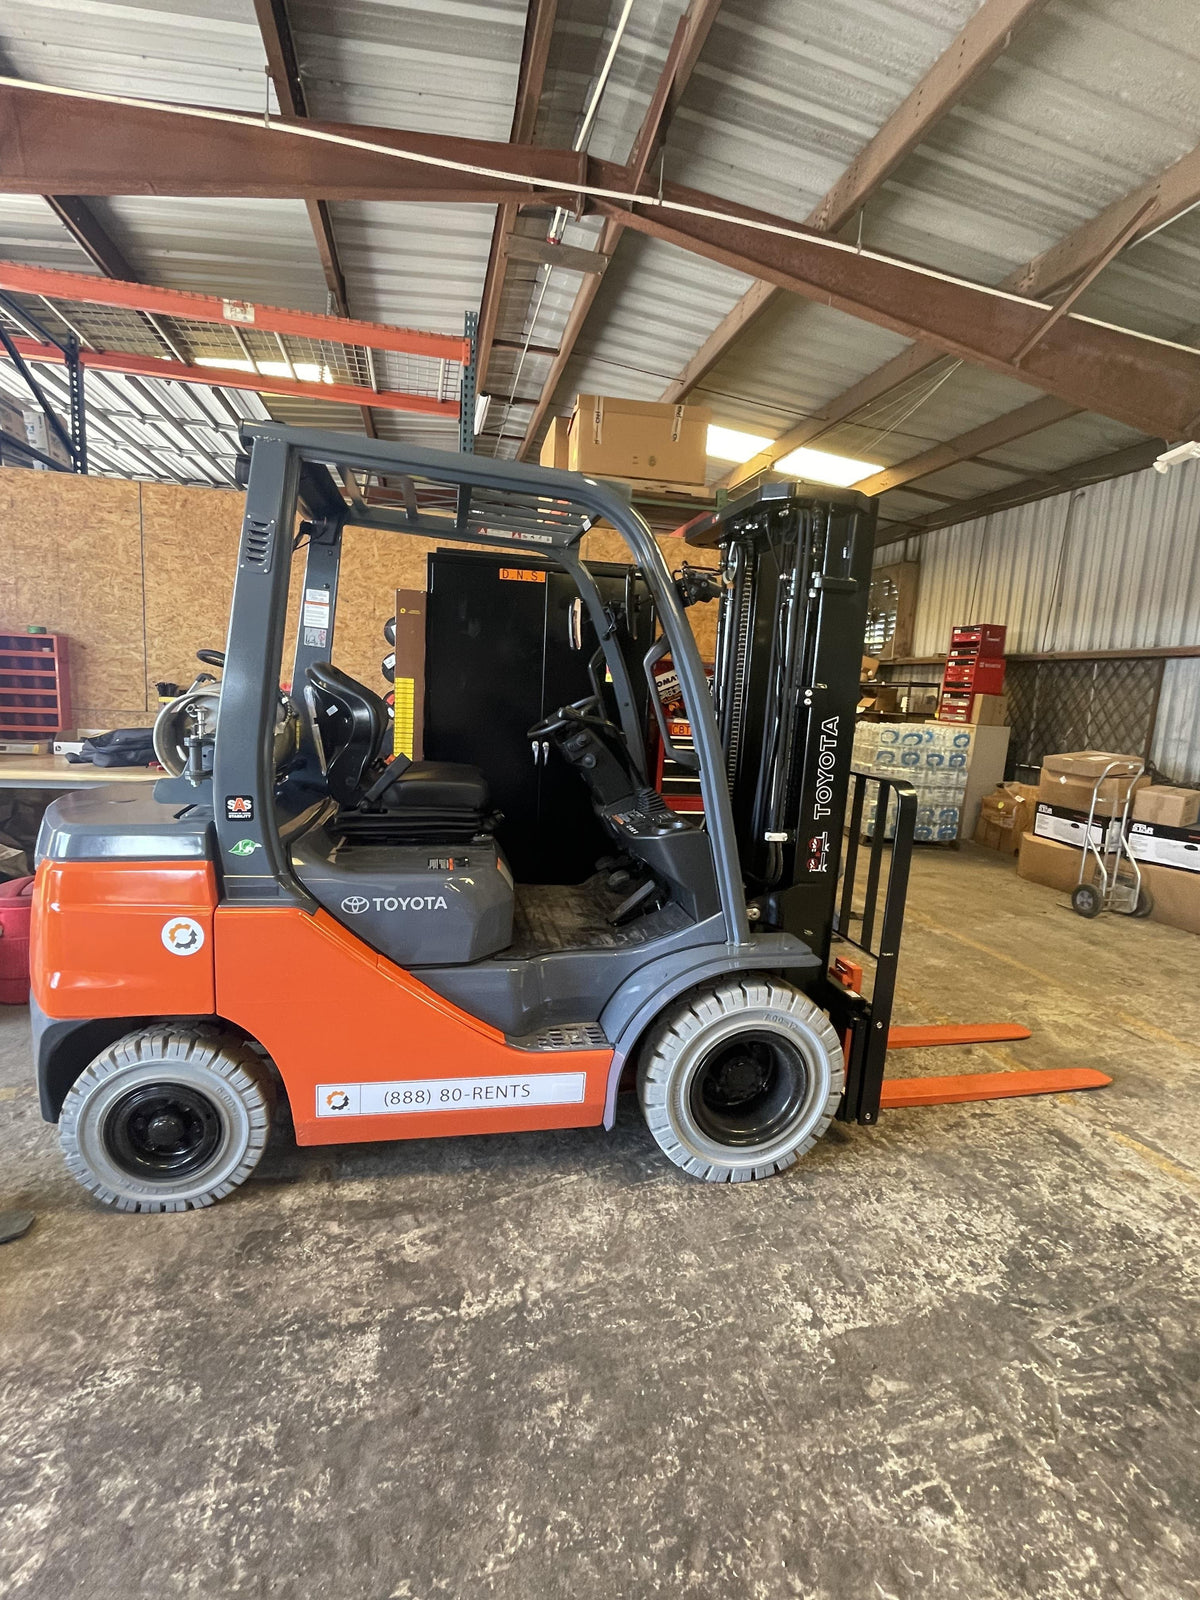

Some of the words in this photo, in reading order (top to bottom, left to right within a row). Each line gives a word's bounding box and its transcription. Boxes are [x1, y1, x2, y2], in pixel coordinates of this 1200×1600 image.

[813, 715, 840, 821] TOYOTA
[226, 797, 252, 812] SAS
[372, 896, 448, 912] TOYOTA
[384, 1089, 431, 1107] (888)
[439, 1084, 531, 1102] 80-RENTS
